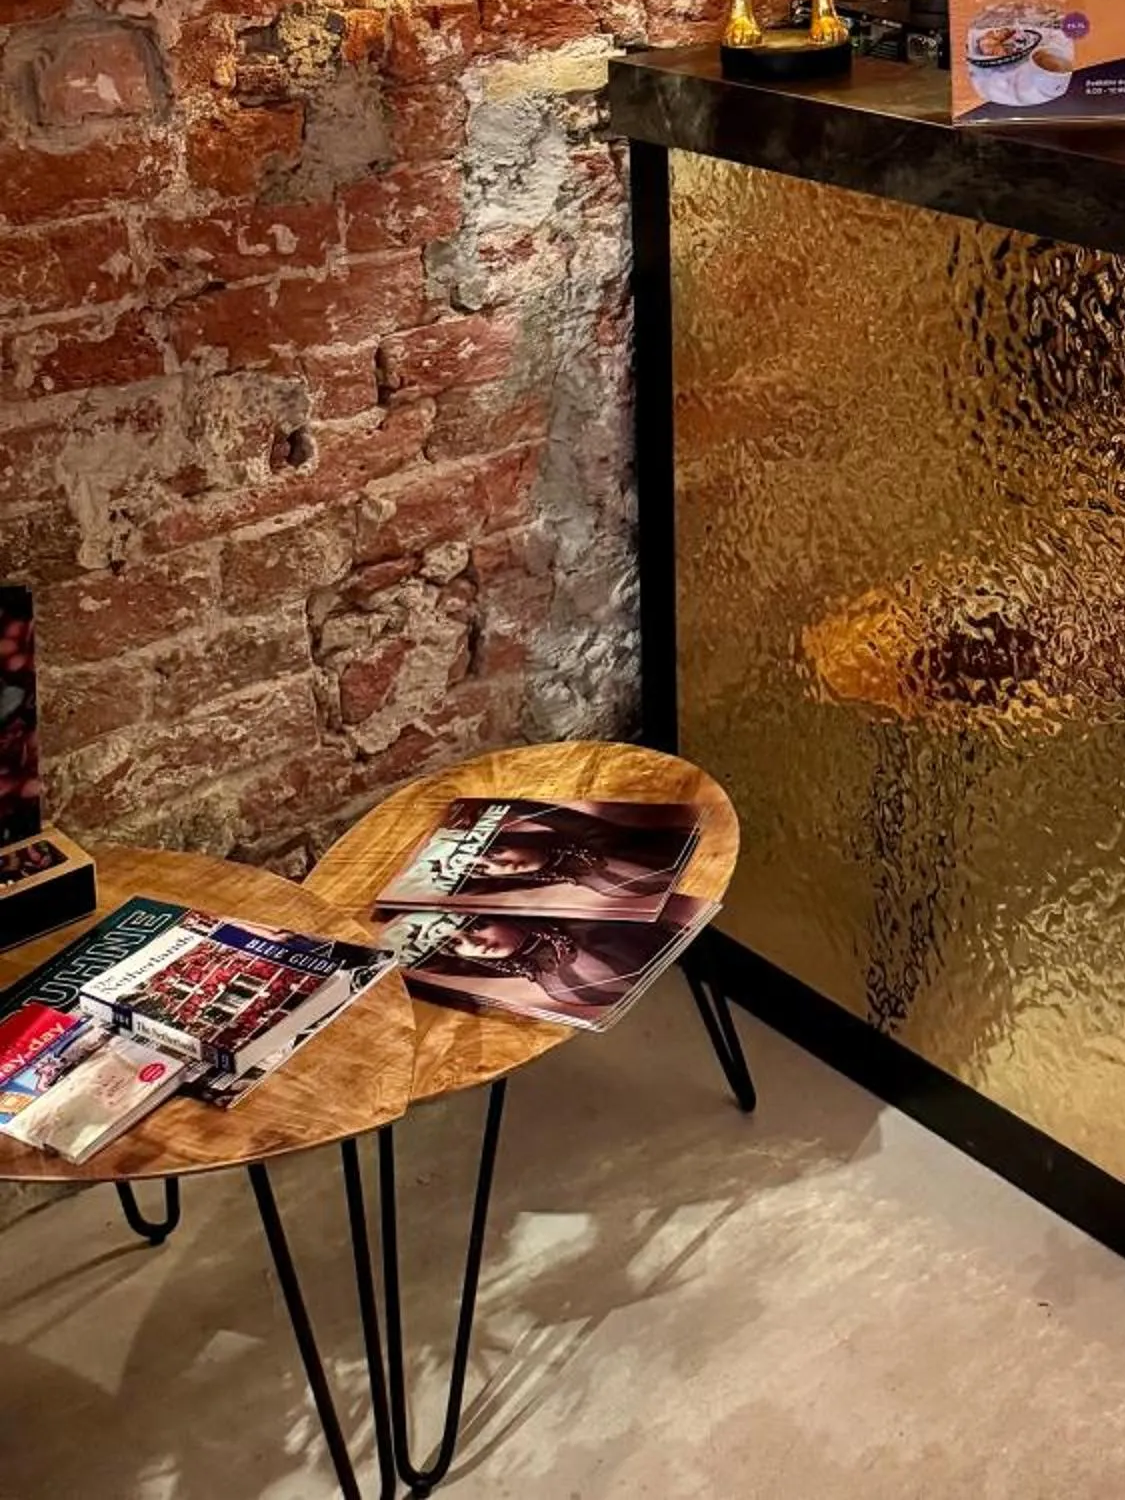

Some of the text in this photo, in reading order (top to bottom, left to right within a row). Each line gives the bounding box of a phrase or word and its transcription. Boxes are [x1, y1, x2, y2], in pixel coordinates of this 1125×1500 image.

[431, 804, 511, 892] MAGAZINE
[246, 938, 342, 975] BLUE GUIDE
